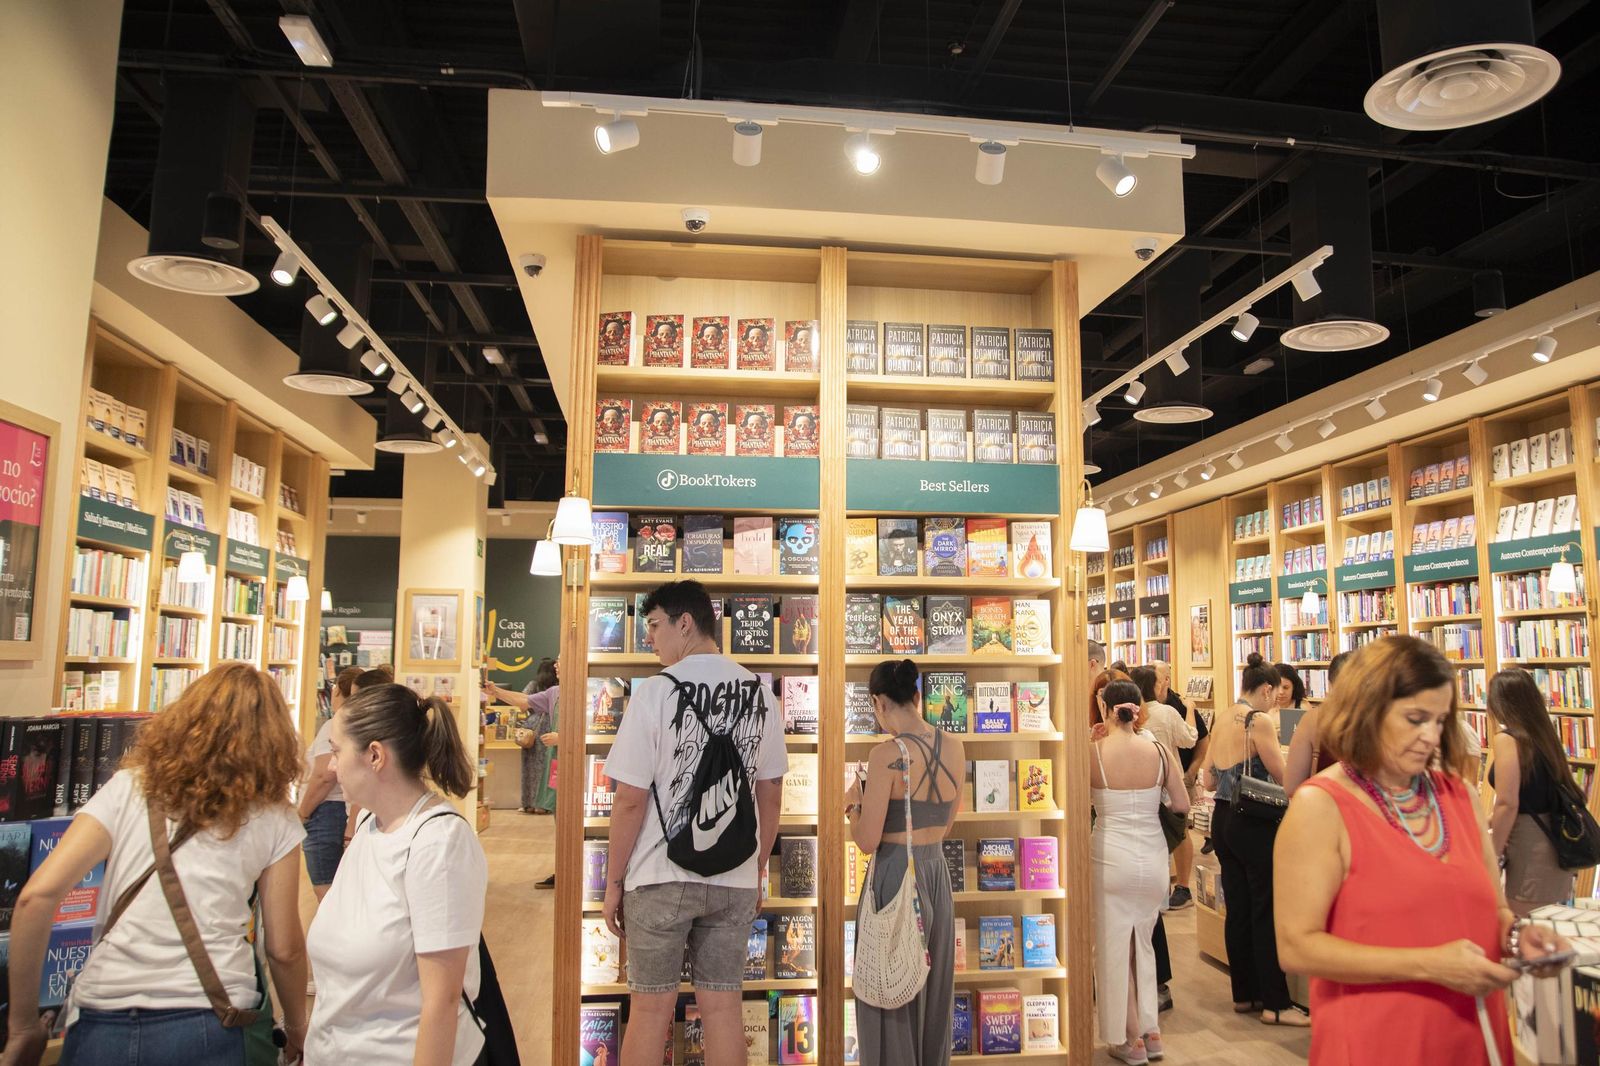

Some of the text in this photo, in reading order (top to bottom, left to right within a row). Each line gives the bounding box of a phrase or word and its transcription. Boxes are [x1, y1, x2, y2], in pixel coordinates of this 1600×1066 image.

[847, 329, 875, 341] ATRICIA
[888, 331, 920, 343] PATRICIA
[932, 332, 964, 345] PATRICIA
[975, 334, 1007, 346] PATRICIA
[1019, 337, 1050, 349] PATRICIA
[887, 345, 921, 356] CORNWELL
[930, 346, 965, 358] CORNWELL
[974, 348, 1008, 360] CORNWELL
[1018, 351, 1051, 361] CORNWELL
[888, 359, 921, 371] QUANTUM
[932, 361, 964, 373] QUANTUM
[976, 362, 1008, 375] QUANTUM
[1018, 364, 1051, 377] QUANTUM
[847, 414, 875, 426] ATRICIA
[932, 416, 964, 429] PATRICIA
[977, 418, 1009, 430] PATRICIA
[1021, 420, 1052, 432] PATRICIA
[976, 432, 1010, 443] CORNWELL
[1020, 433, 1053, 445] CORNWELL
[977, 447, 1010, 460] QUANTUM
[1021, 448, 1053, 461] QUANTUM
[3, 460, 21, 478] no
[679, 474, 757, 488] BookTokers
[920, 480, 989, 493] Best Sellers
[644, 545, 668, 557] REAL
[1500, 550, 1521, 560] Autores
[1413, 564, 1430, 572] Autores
[896, 605, 911, 614] THE
[893, 616, 913, 624] YEAR
[933, 612, 962, 622] ONYX
[499, 619, 525, 630] Casa
[890, 626, 918, 635] OF THE
[932, 625, 964, 636] STORM
[510, 630, 525, 639] del
[890, 636, 919, 645] LOCUST
[497, 638, 525, 648] Libro
[928, 676, 966, 684] STEPHEN
[931, 685, 963, 695] KING
[795, 936, 813, 944] MAR
[48, 945, 92, 961] NUEST
[57, 960, 83, 973] LUG
[49, 974, 67, 986] EN
[581, 1018, 613, 1030] CAÍDA
[985, 1015, 1017, 1025] SWEPT
[989, 1025, 1014, 1035] AWAY
[783, 1022, 814, 1054] 13
